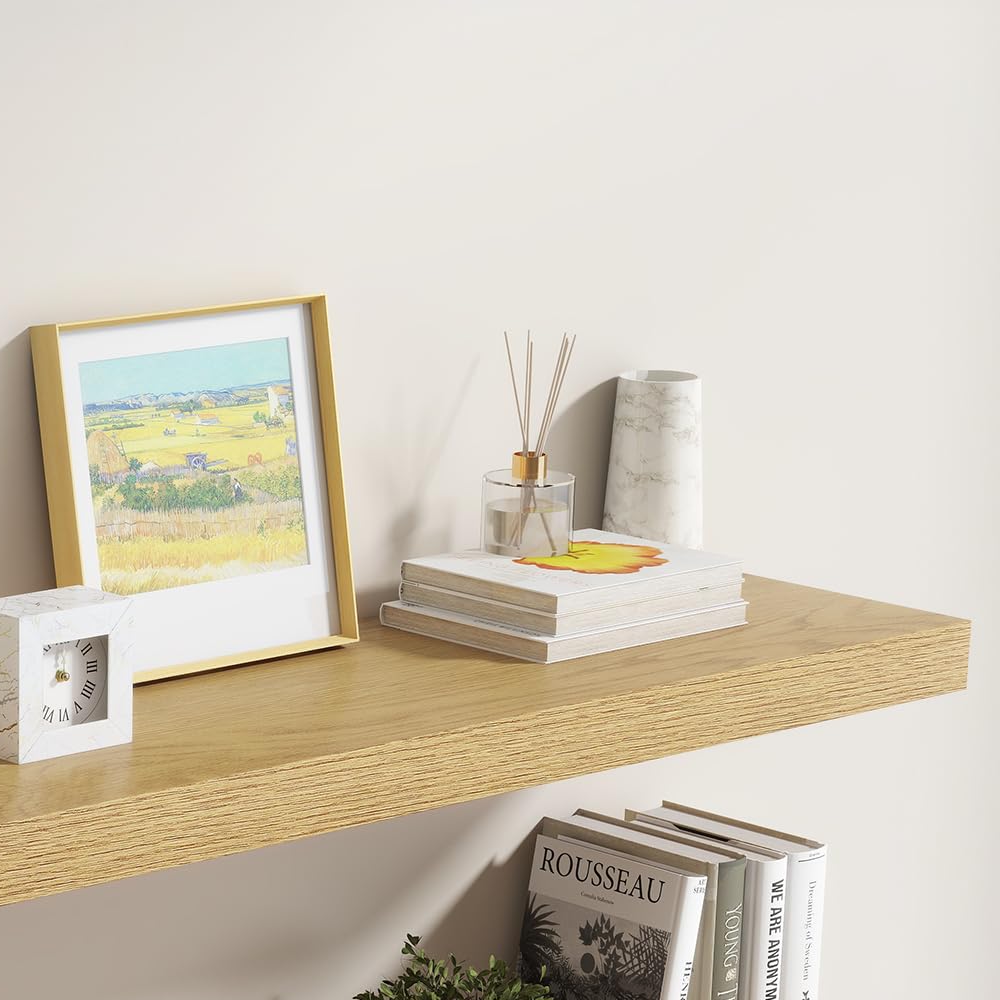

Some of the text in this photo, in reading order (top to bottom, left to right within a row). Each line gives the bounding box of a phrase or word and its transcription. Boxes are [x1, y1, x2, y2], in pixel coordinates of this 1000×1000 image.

[86, 659, 98, 674] III
[80, 679, 96, 700] IIII
[539, 847, 666, 904] ROUSSEAU
[770, 879, 785, 904] WE
[768, 907, 782, 936] ARE
[804, 880, 817, 929] Dreaming
[723, 903, 742, 968] YOUNG
[802, 942, 813, 981] Sweden
